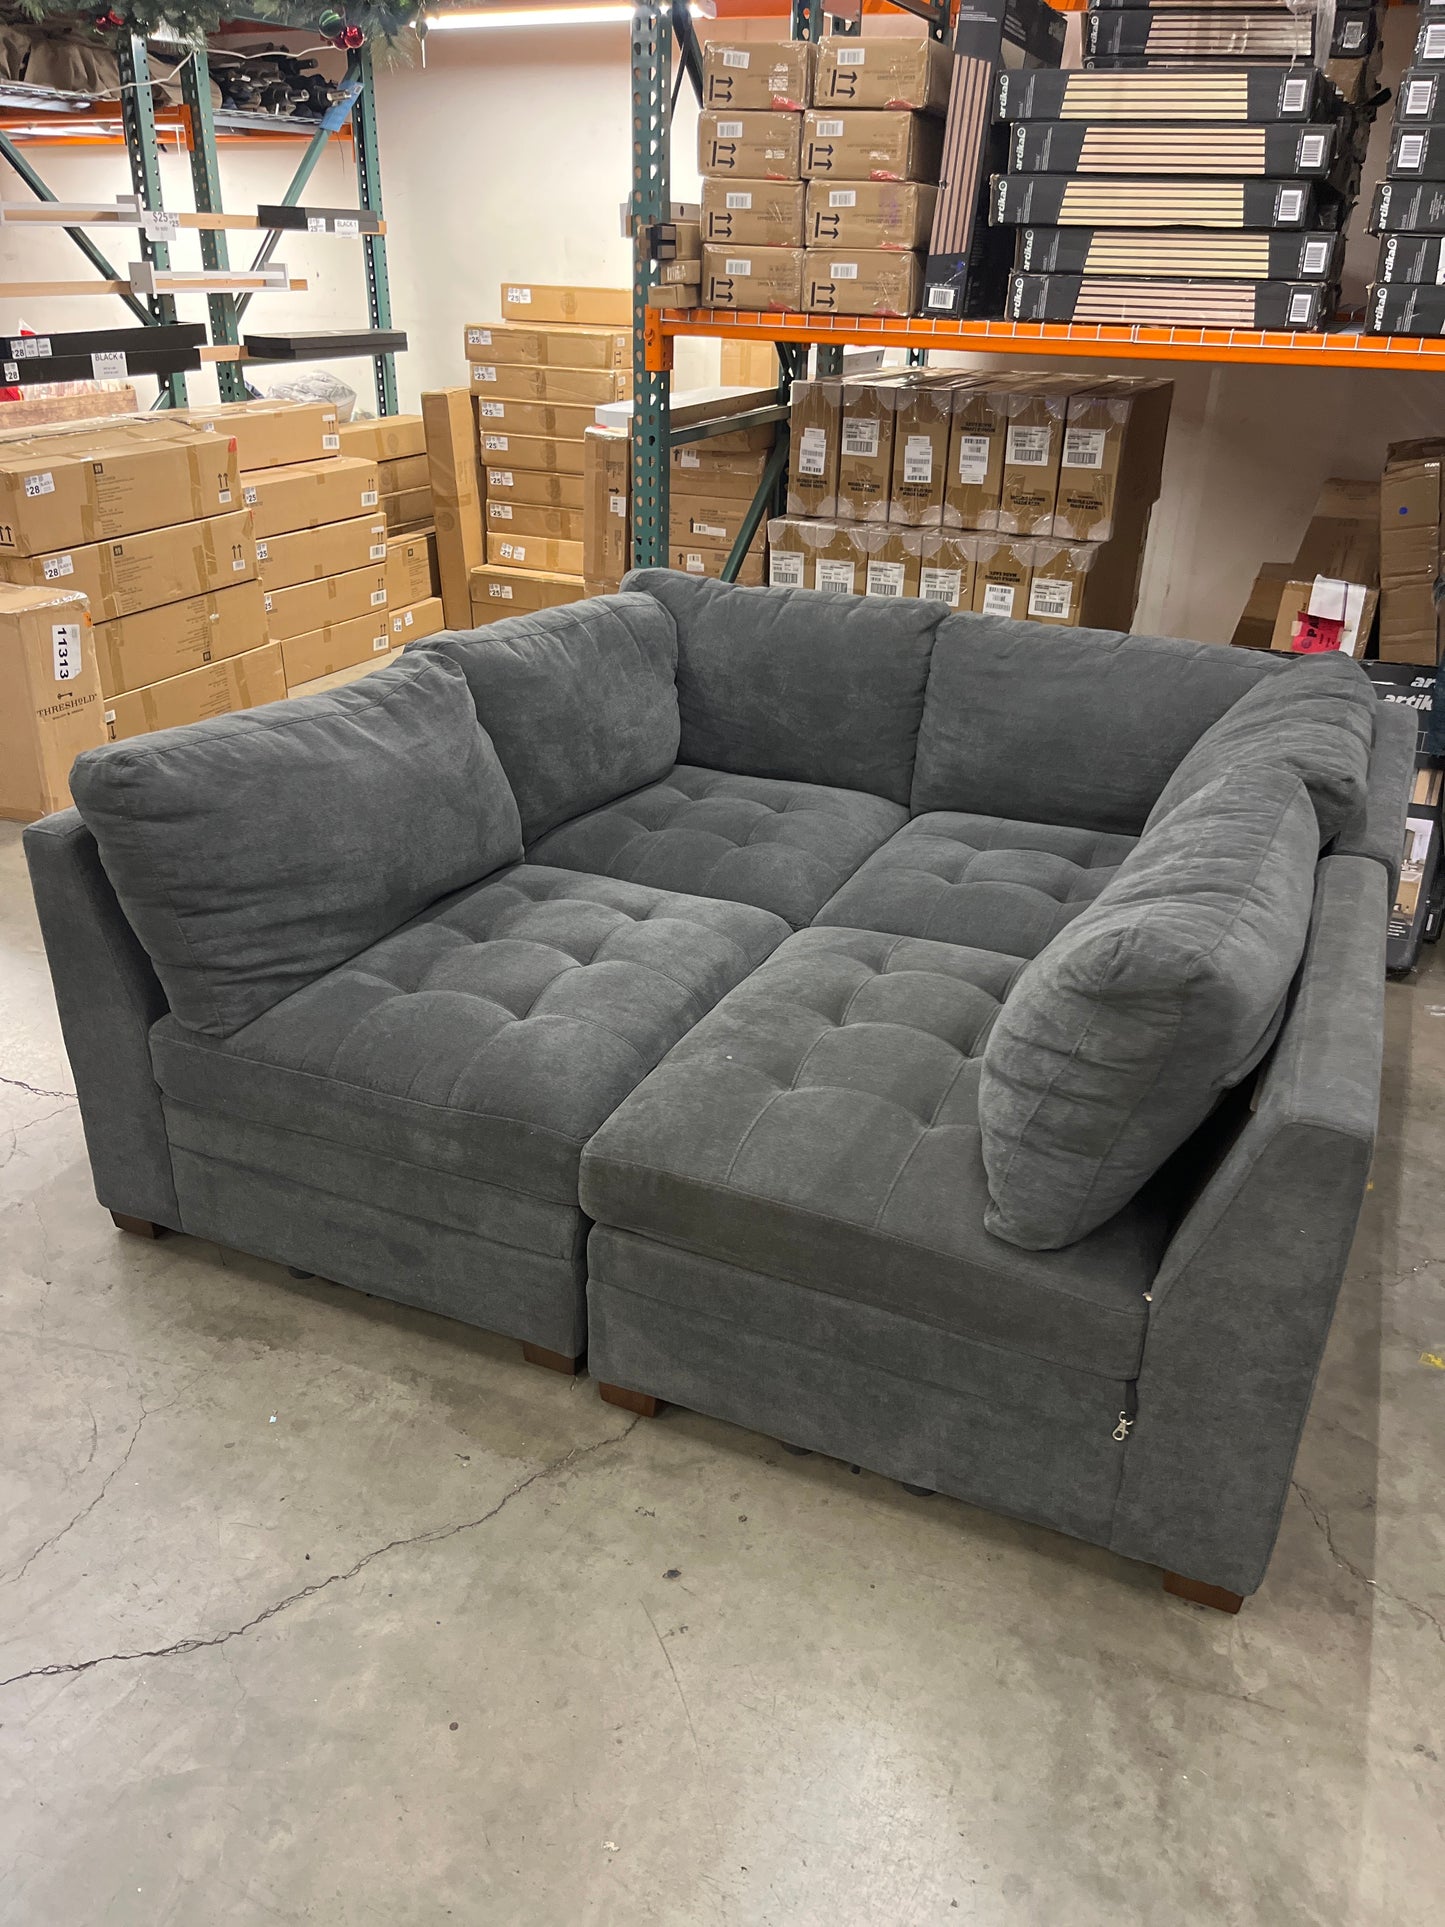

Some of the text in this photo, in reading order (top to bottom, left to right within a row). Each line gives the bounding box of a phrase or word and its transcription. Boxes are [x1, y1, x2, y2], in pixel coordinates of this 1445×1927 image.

[1379, 196, 1391, 230] artika
[1384, 248, 1397, 283] artika
[1374, 297, 1387, 332] artika
[57, 627, 69, 679] 11313
[37, 693, 95, 717] THRESHOLD
[1383, 694, 1433, 711] artik
